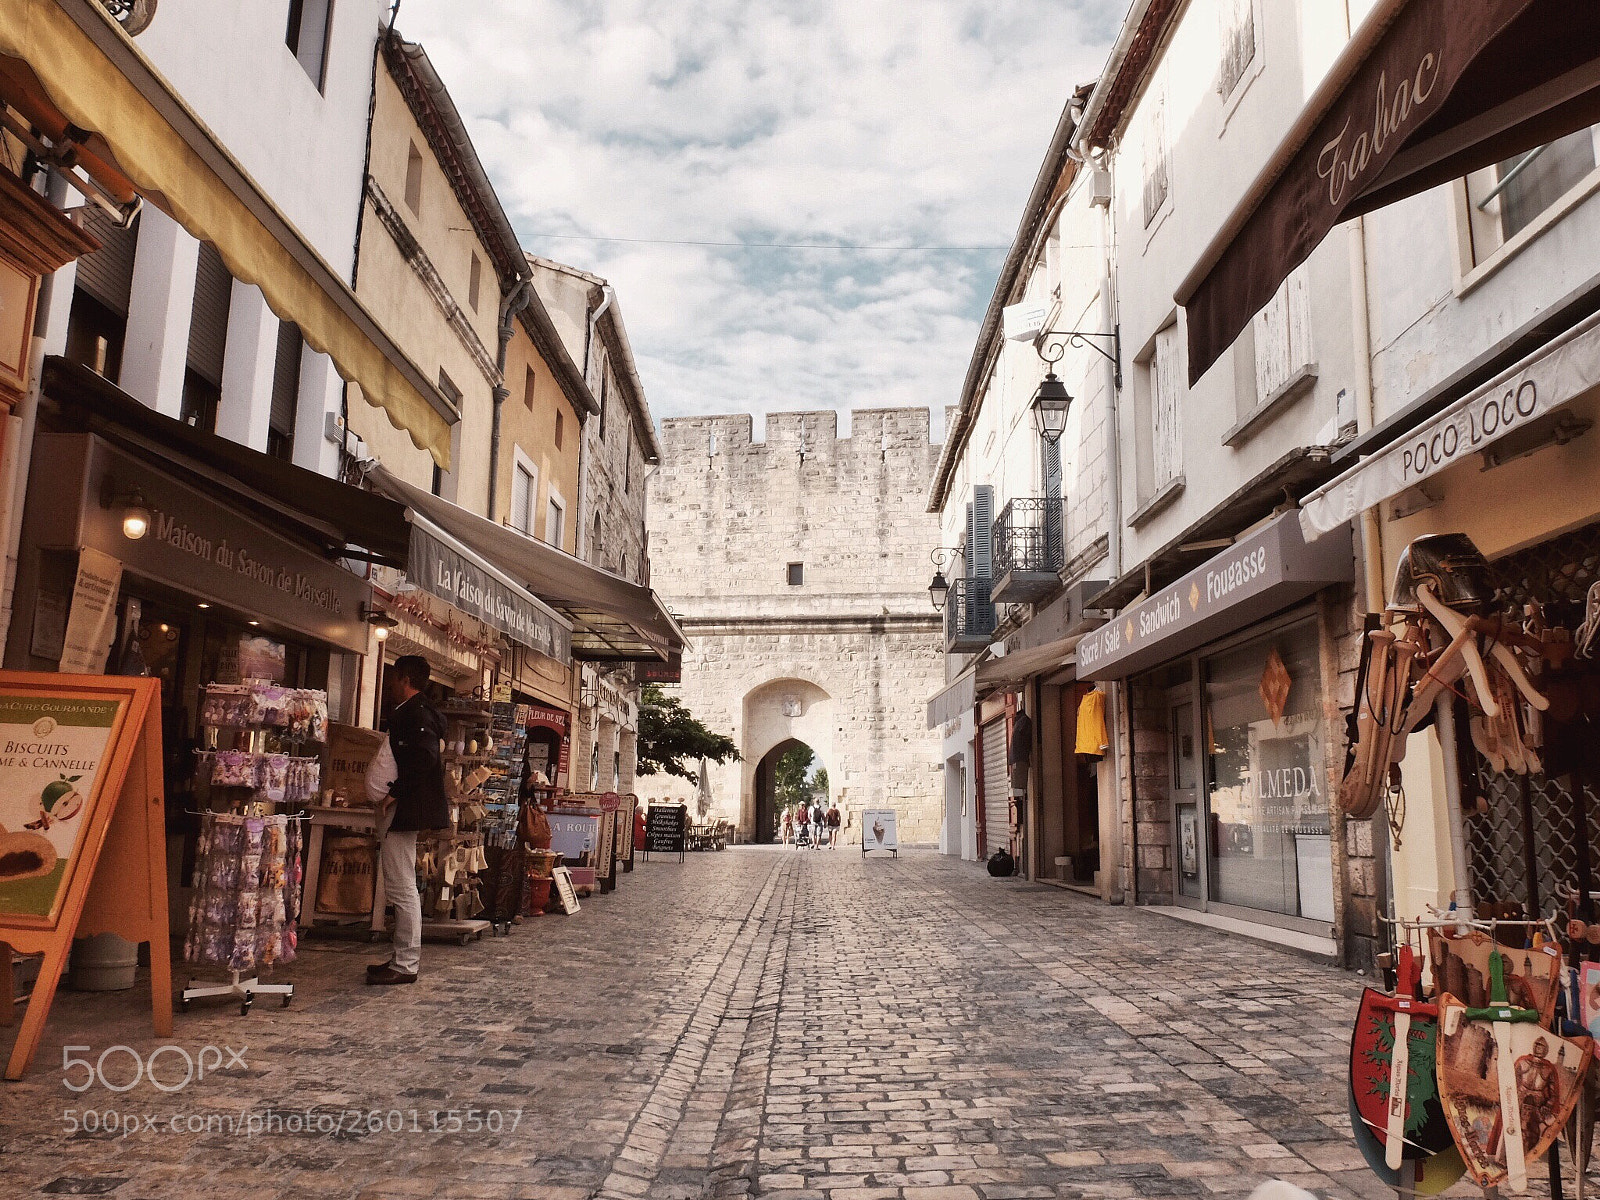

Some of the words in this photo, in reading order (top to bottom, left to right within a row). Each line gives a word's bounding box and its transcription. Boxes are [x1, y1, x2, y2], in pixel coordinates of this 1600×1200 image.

[1317, 48, 1443, 205] Tabac
[1403, 424, 1458, 481] POCO
[1469, 379, 1537, 445] LOCO
[156, 512, 212, 561] Maison
[215, 539, 234, 570] du
[237, 549, 274, 587] Savon
[277, 567, 292, 592] de
[294, 573, 342, 614] Marseille
[437, 559, 452, 591] La
[485, 588, 495, 616] du
[1104, 623, 1120, 655] Salé
[1139, 591, 1181, 638] Sandwich
[1206, 546, 1267, 603] Fougasse
[40, 703, 107, 714] GOURMANDE
[546, 713, 554, 722] DE
[554, 714, 566, 727] SEL
[4, 740, 70, 756] BISCUITS
[18, 758, 28, 768] &
[32, 757, 96, 770] CANNELLE
[1291, 824, 1323, 835] FOUGASSE
